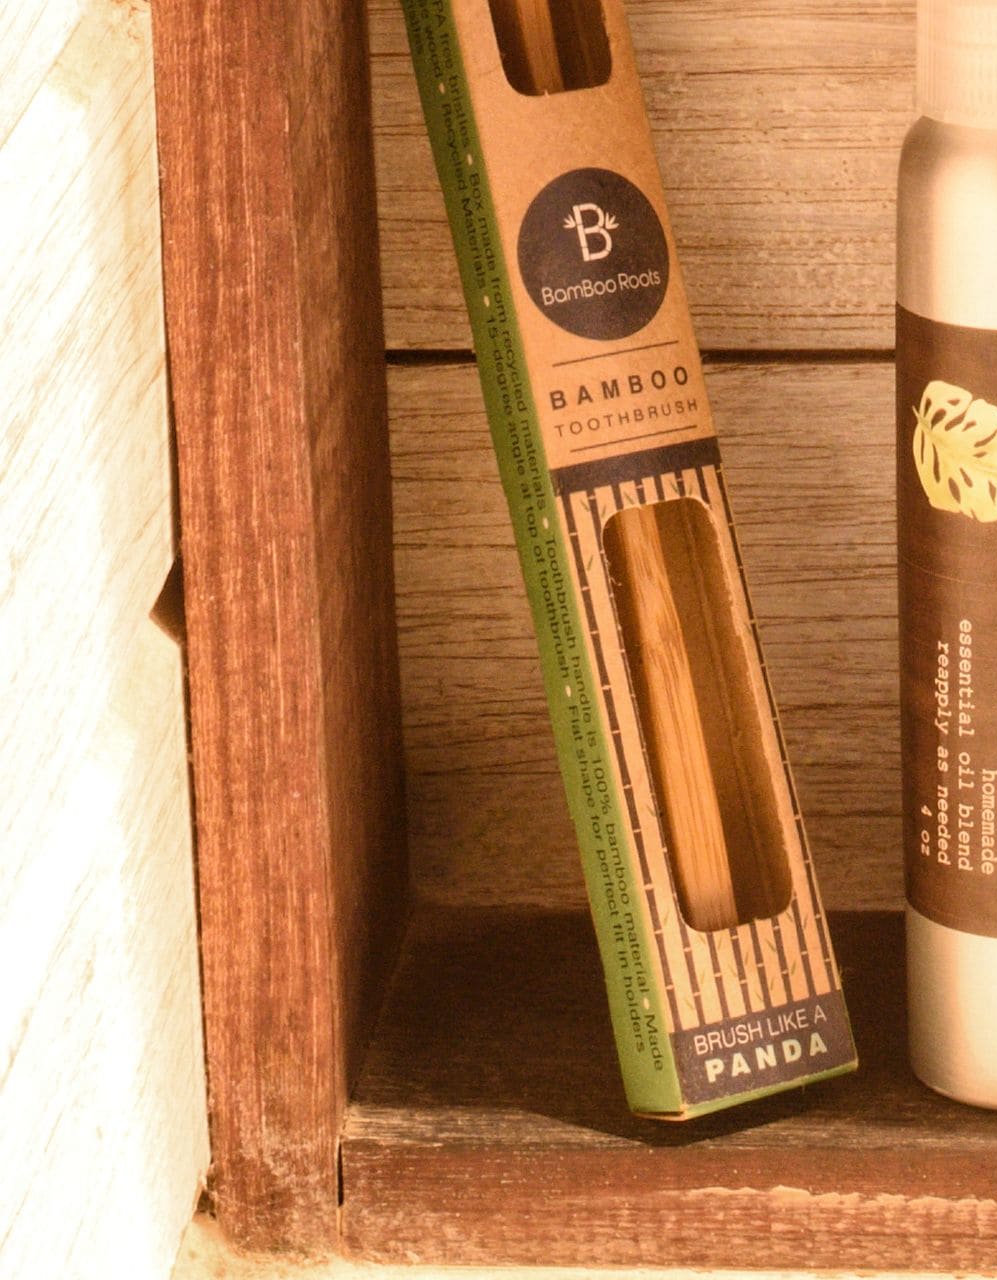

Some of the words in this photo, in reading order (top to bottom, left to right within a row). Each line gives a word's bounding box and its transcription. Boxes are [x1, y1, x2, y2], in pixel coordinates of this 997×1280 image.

[541, 277, 617, 306] BamBoo
[618, 269, 661, 291] Roots
[549, 365, 690, 411] BAMBOO
[554, 398, 699, 438] TOOTHBRUSH
[461, 199, 486, 288] Materials
[525, 507, 538, 537] top
[539, 571, 568, 678] toothbrush
[569, 706, 581, 740] Flat
[576, 749, 595, 807] shape
[591, 817, 603, 841] for
[614, 924, 624, 942] fit
[623, 977, 646, 1052] holders
[470, 174, 483, 209] Box
[479, 218, 496, 270] made
[492, 278, 507, 322] from
[501, 331, 525, 411] recycled
[521, 420, 546, 510] materials
[546, 539, 576, 648] Toothbrush
[571, 657, 591, 722] handle
[592, 759, 610, 813] 100%
[606, 824, 630, 904] bamboo
[624, 913, 648, 992] material
[645, 1014, 664, 1070] Made
[934, 640, 952, 736] reapply
[958, 619, 975, 737] essential
[937, 745, 949, 772] as
[958, 751, 975, 790] oil
[920, 805, 932, 817] 4
[937, 784, 951, 867] needed
[921, 829, 930, 857] oz
[958, 803, 974, 872] blend
[693, 1021, 763, 1055] BRUSH
[766, 1008, 809, 1036] LIKE
[813, 1004, 827, 1024] A
[705, 1032, 827, 1083] PANDA
